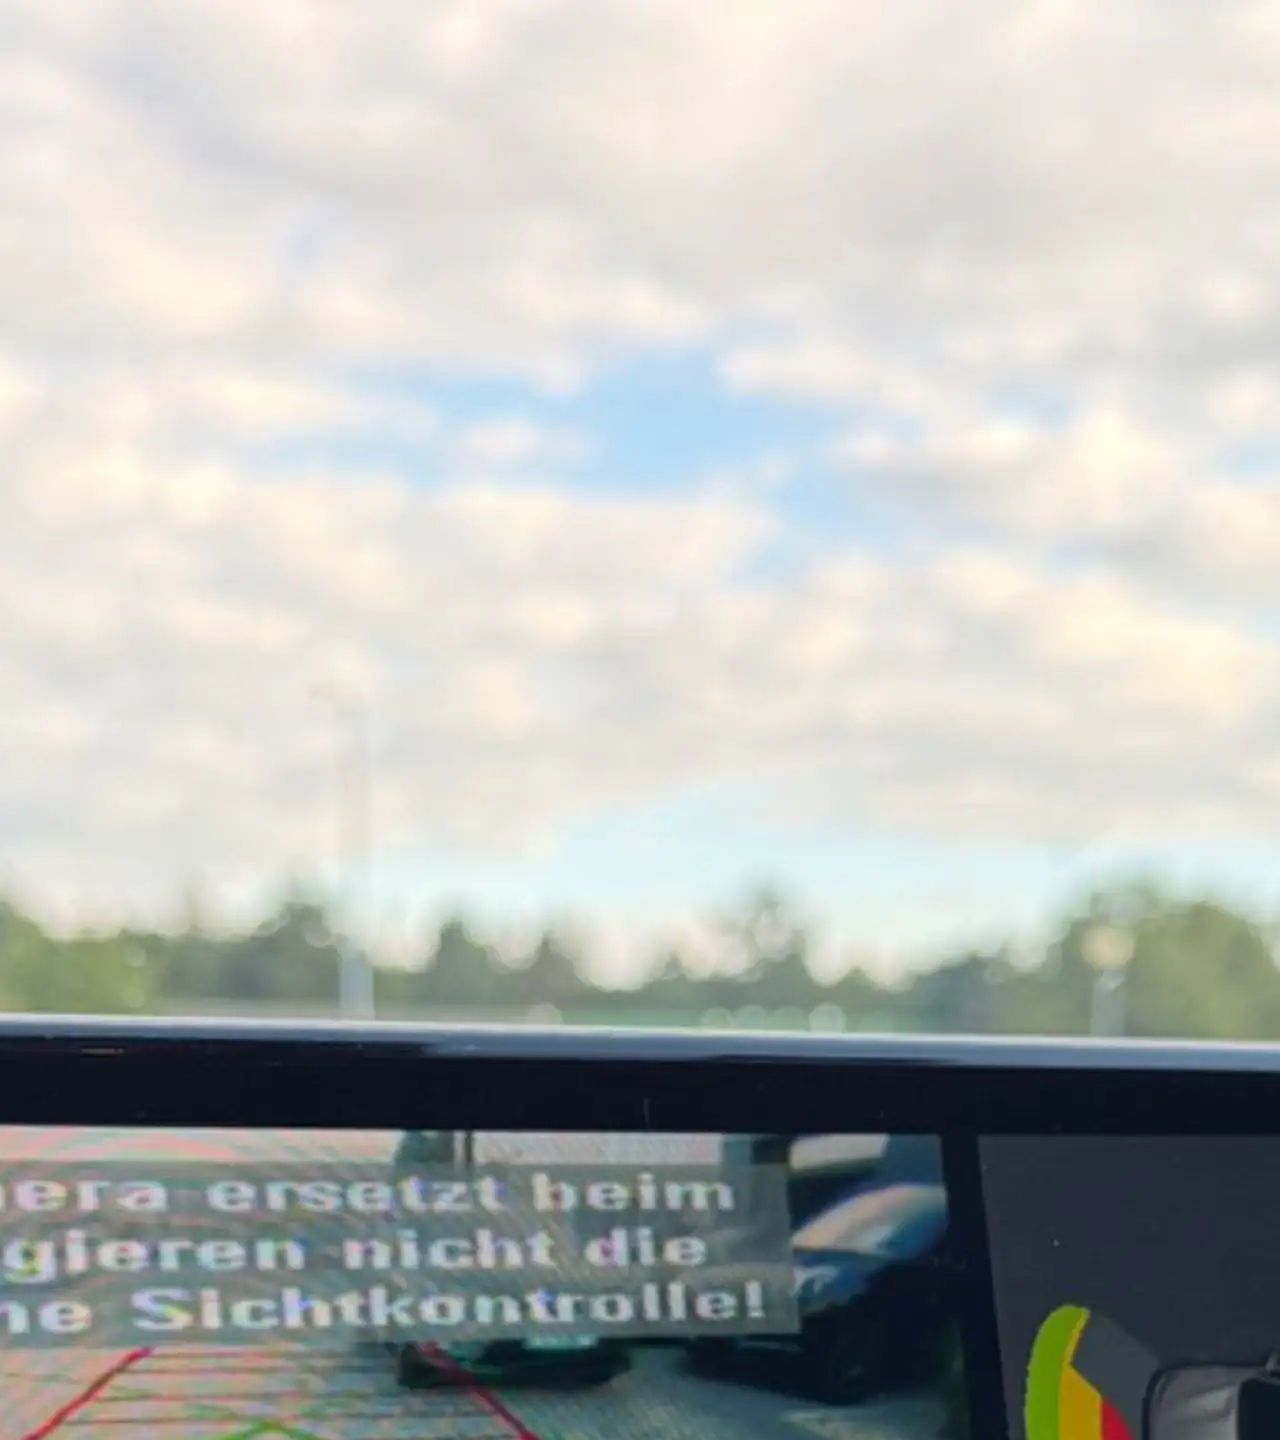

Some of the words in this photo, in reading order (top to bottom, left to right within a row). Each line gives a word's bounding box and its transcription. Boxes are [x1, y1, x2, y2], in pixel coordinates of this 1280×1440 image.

[206, 1172, 503, 1213] ersetzt
[533, 1172, 736, 1212] beim
[344, 1227, 556, 1271] nicht
[584, 1224, 708, 1268] die
[131, 1283, 766, 1332] Sichtkontrolle!
